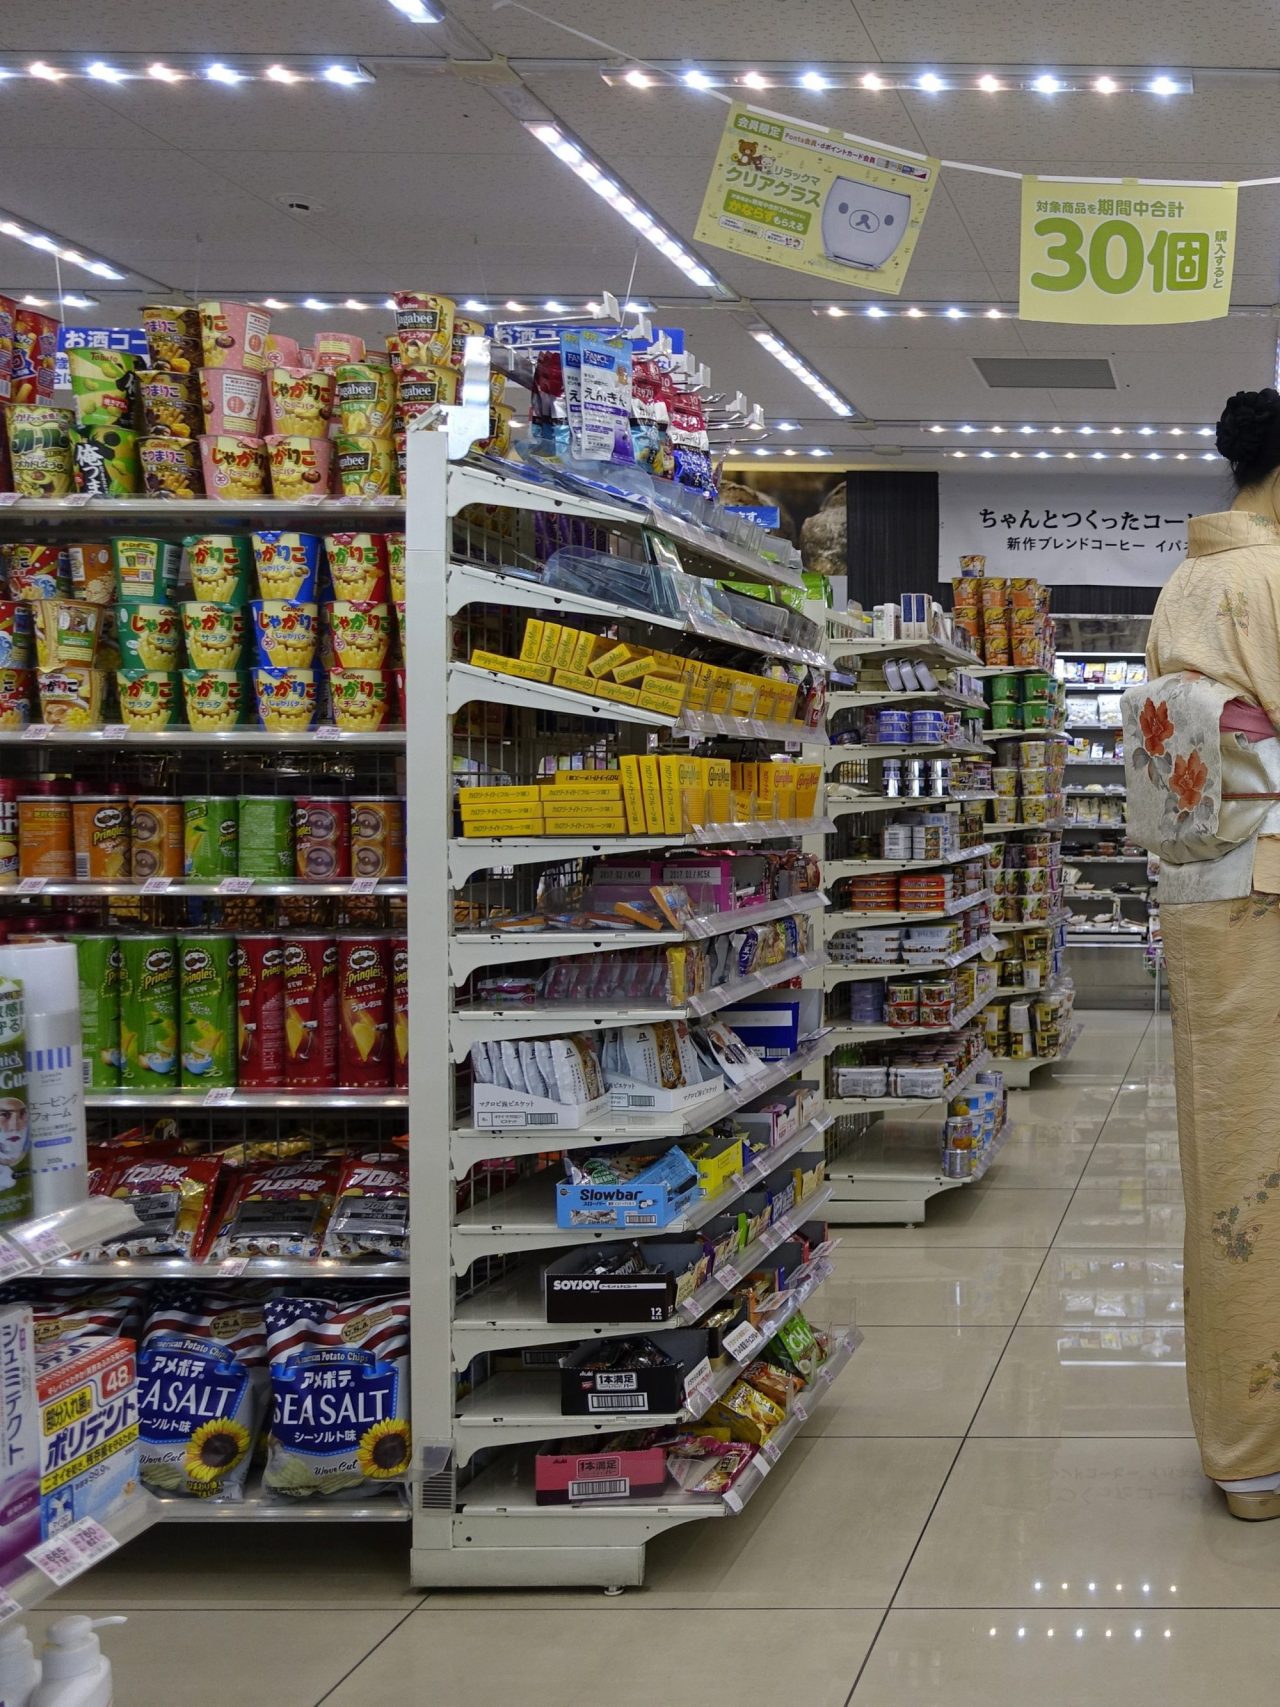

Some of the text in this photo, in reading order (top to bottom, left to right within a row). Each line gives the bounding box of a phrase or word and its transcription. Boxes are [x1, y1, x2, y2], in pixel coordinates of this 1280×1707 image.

[774, 164, 821, 187] リラックマ
[725, 166, 823, 208] クリアグラス
[1036, 199, 1184, 218] 対象商品を期間中合計
[1030, 217, 1210, 295] 30個
[1214, 230, 1228, 289] 購入すると
[583, 351, 610, 363] FANCL
[584, 388, 628, 406] えんきん
[979, 508, 1193, 531] ちゃんとつくったコー
[1007, 536, 1145, 551] 新作ブレンドコーヒー
[350, 633, 374, 642] チーズ
[344, 700, 367, 708] チーズ
[348, 967, 382, 988] Pringles
[356, 982, 376, 993] NEW
[580, 1188, 643, 1202] Slowbar
[553, 1279, 600, 1292] SOYJOY
[651, 1307, 663, 1316] 12
[213, 1318, 241, 1329] U.S.A
[343, 1320, 370, 1336] U.S.A
[321, 1351, 346, 1362] Potato
[347, 1352, 369, 1363] Chips
[151, 1356, 206, 1378] アメポテ
[105, 1364, 129, 1393] 48
[300, 1370, 352, 1390] アメポテ
[598, 1374, 634, 1385] 1本満足
[137, 1376, 237, 1418] EA SALT
[273, 1389, 390, 1426] SEA SALT
[45, 1397, 136, 1471] ポリデント
[294, 1429, 357, 1444] シーソルト味
[139, 1451, 185, 1464] Wave Cut
[314, 1459, 358, 1476] Wave Cut
[578, 1460, 617, 1472] 1本満足
